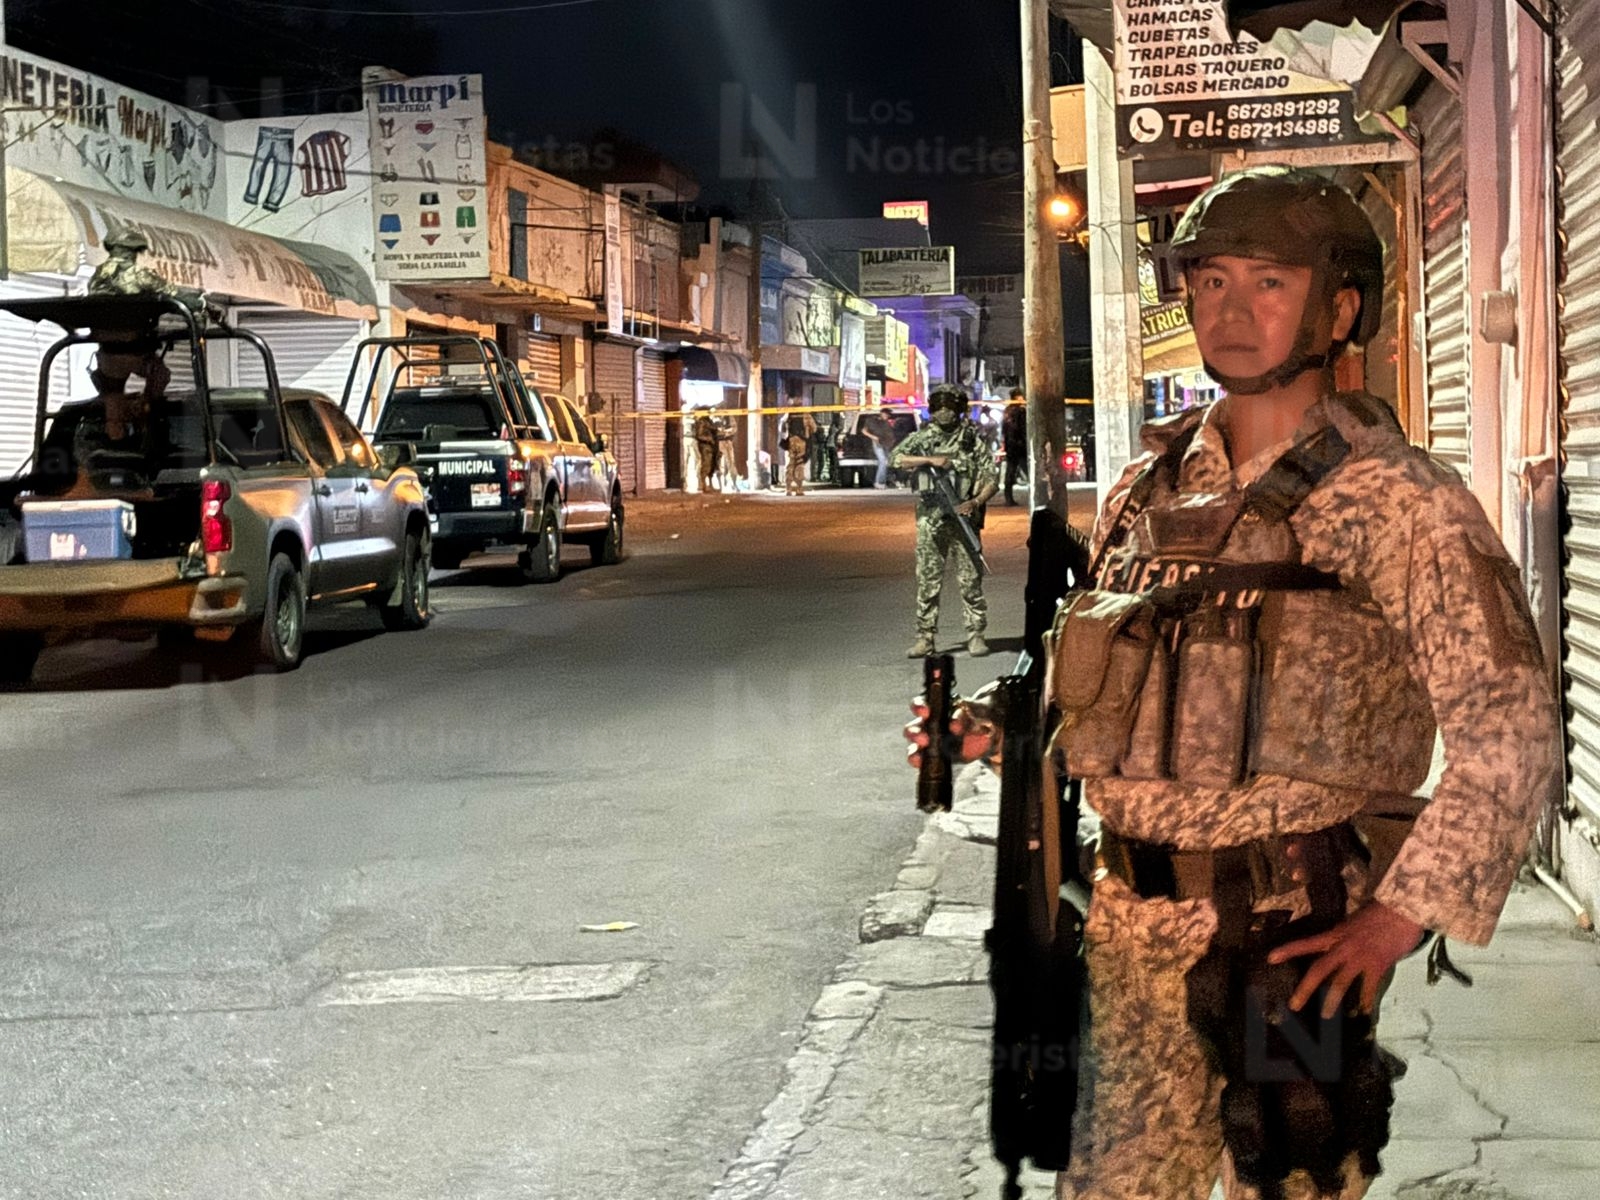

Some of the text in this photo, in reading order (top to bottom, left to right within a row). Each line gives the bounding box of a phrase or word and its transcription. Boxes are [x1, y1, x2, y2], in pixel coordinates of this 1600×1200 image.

[1127, 9, 1213, 27] HAMACAS
[1128, 27, 1210, 44] CUBETAS
[1129, 41, 1258, 62] TRAPEADORES
[1129, 57, 1285, 79] TABLAS TAQUERO
[1129, 75, 1290, 97] BOLSAS MERCADO
[1227, 98, 1340, 120] 6673891292
[1168, 112, 1224, 138] Tel:
[1228, 118, 1341, 139] 6672134986
[438, 459, 496, 475] MUNICIPAL
